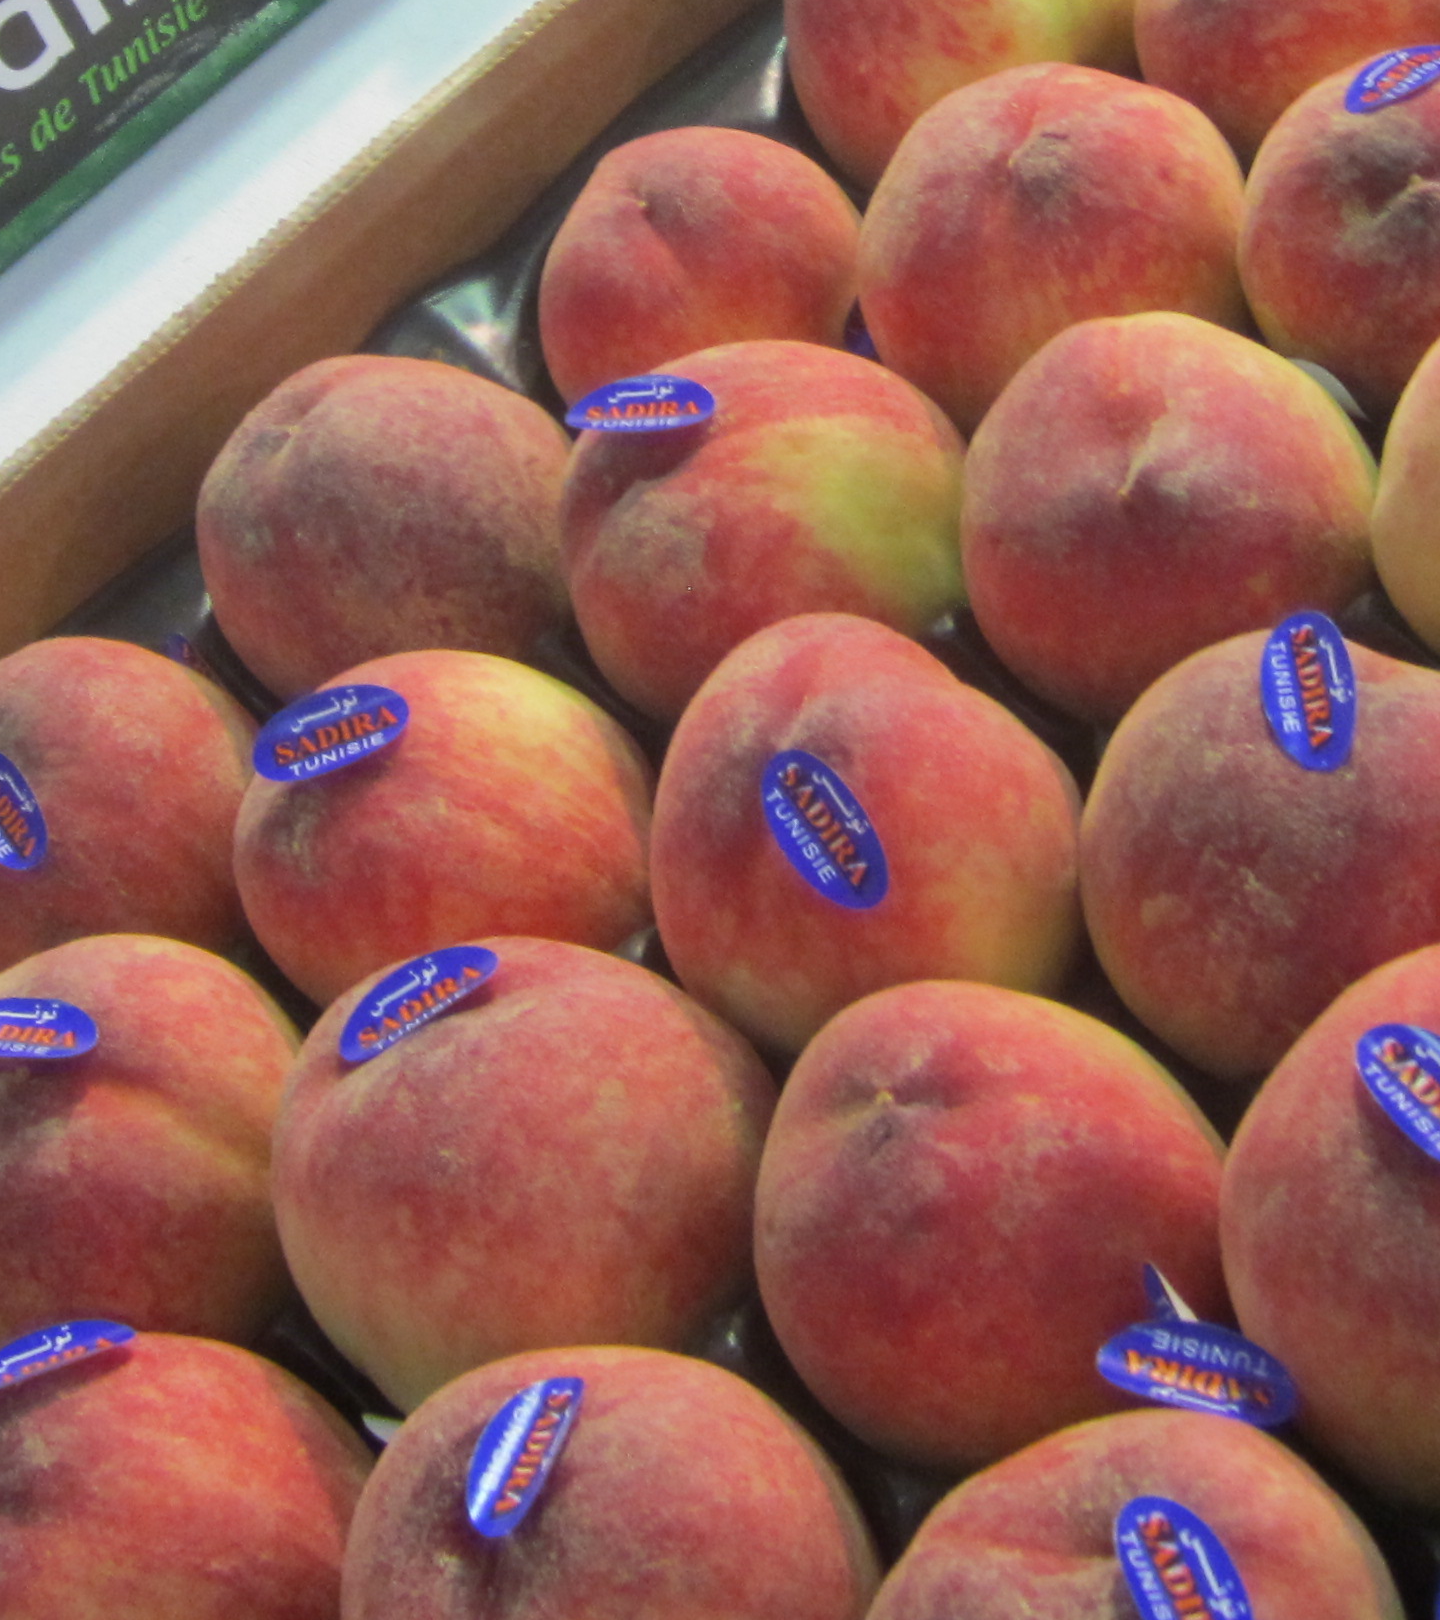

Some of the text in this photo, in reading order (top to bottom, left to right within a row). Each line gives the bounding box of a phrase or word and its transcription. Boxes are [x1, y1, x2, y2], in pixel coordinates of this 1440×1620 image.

[30, 98, 77, 152] de
[585, 400, 699, 420] SADIRA
[1269, 640, 1301, 734] TUNISIE
[1291, 624, 1333, 748] SADIRA
[275, 705, 398, 764] SADIRA
[289, 731, 385, 776] TUNISIE
[766, 788, 837, 884] TUNISIE
[777, 762, 868, 886] SADIRA
[359, 966, 481, 1048] SADIRA
[494, 1390, 573, 1512] SADIRA
[1136, 1511, 1212, 1620] SADI
